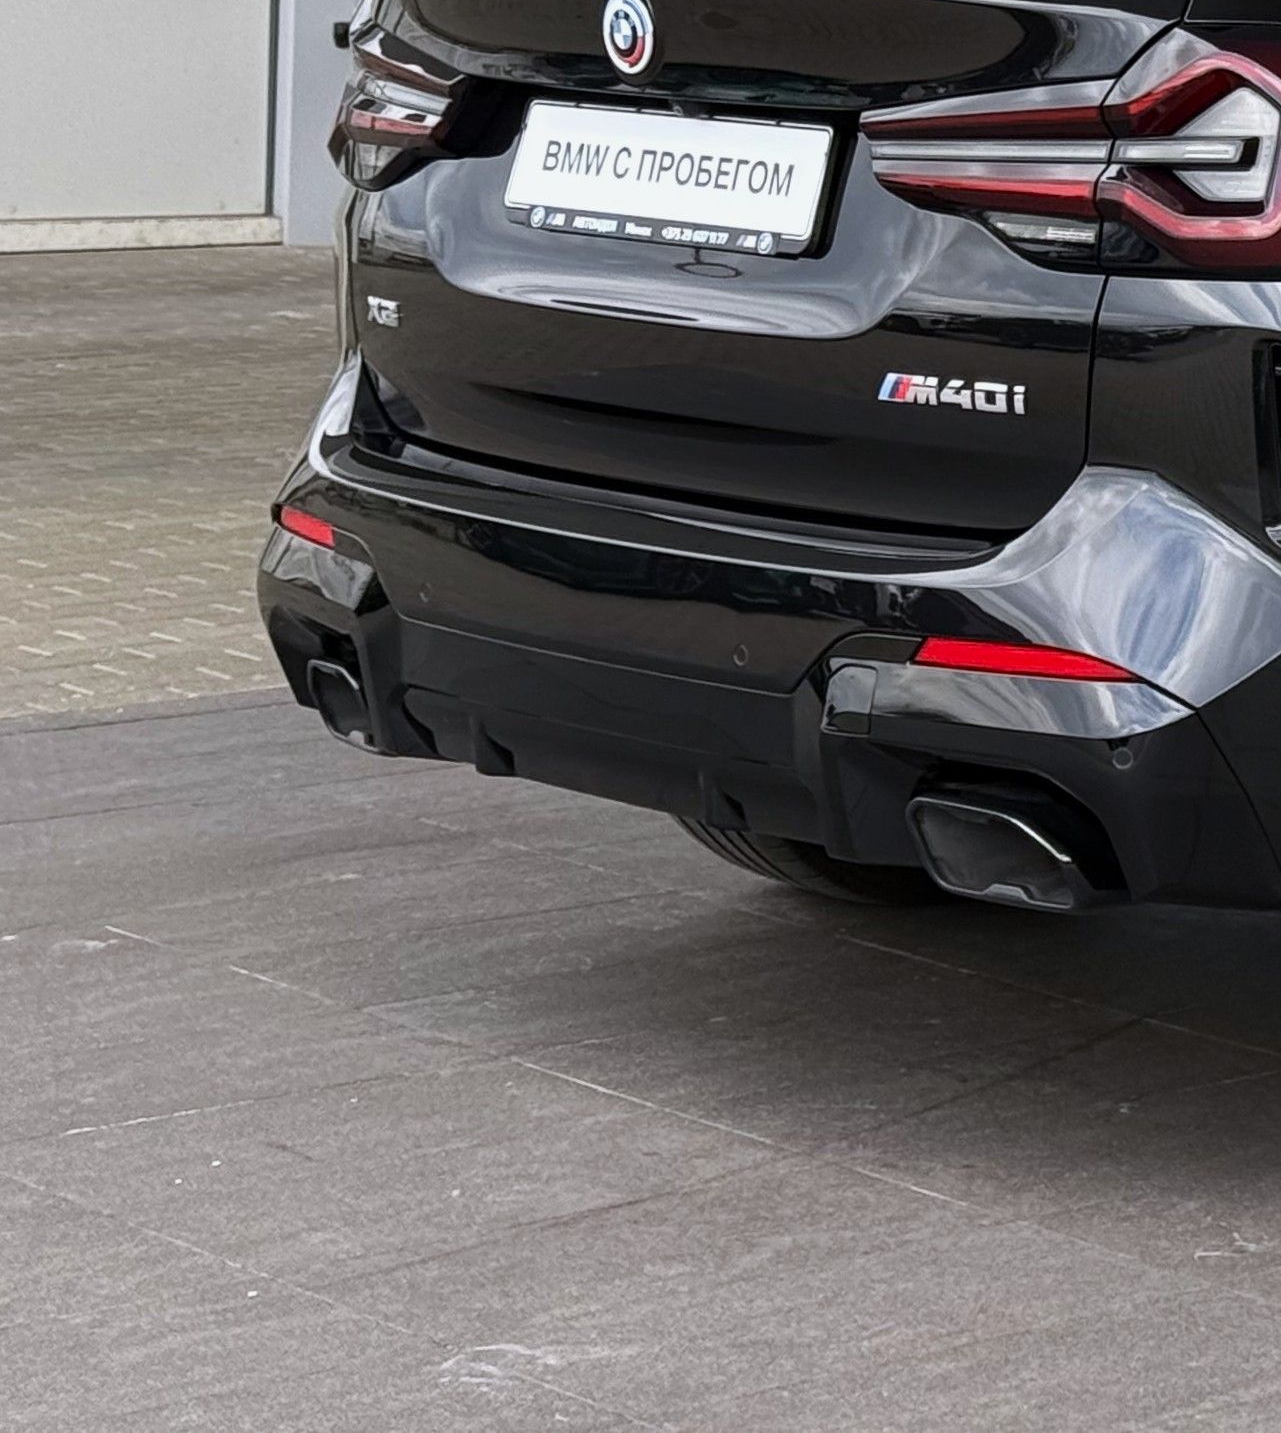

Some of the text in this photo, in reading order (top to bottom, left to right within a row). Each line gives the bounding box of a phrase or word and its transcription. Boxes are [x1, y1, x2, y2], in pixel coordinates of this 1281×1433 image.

[542, 140, 795, 197] BMW С ПРОБЕГОМ
[878, 372, 1025, 414] M40i
